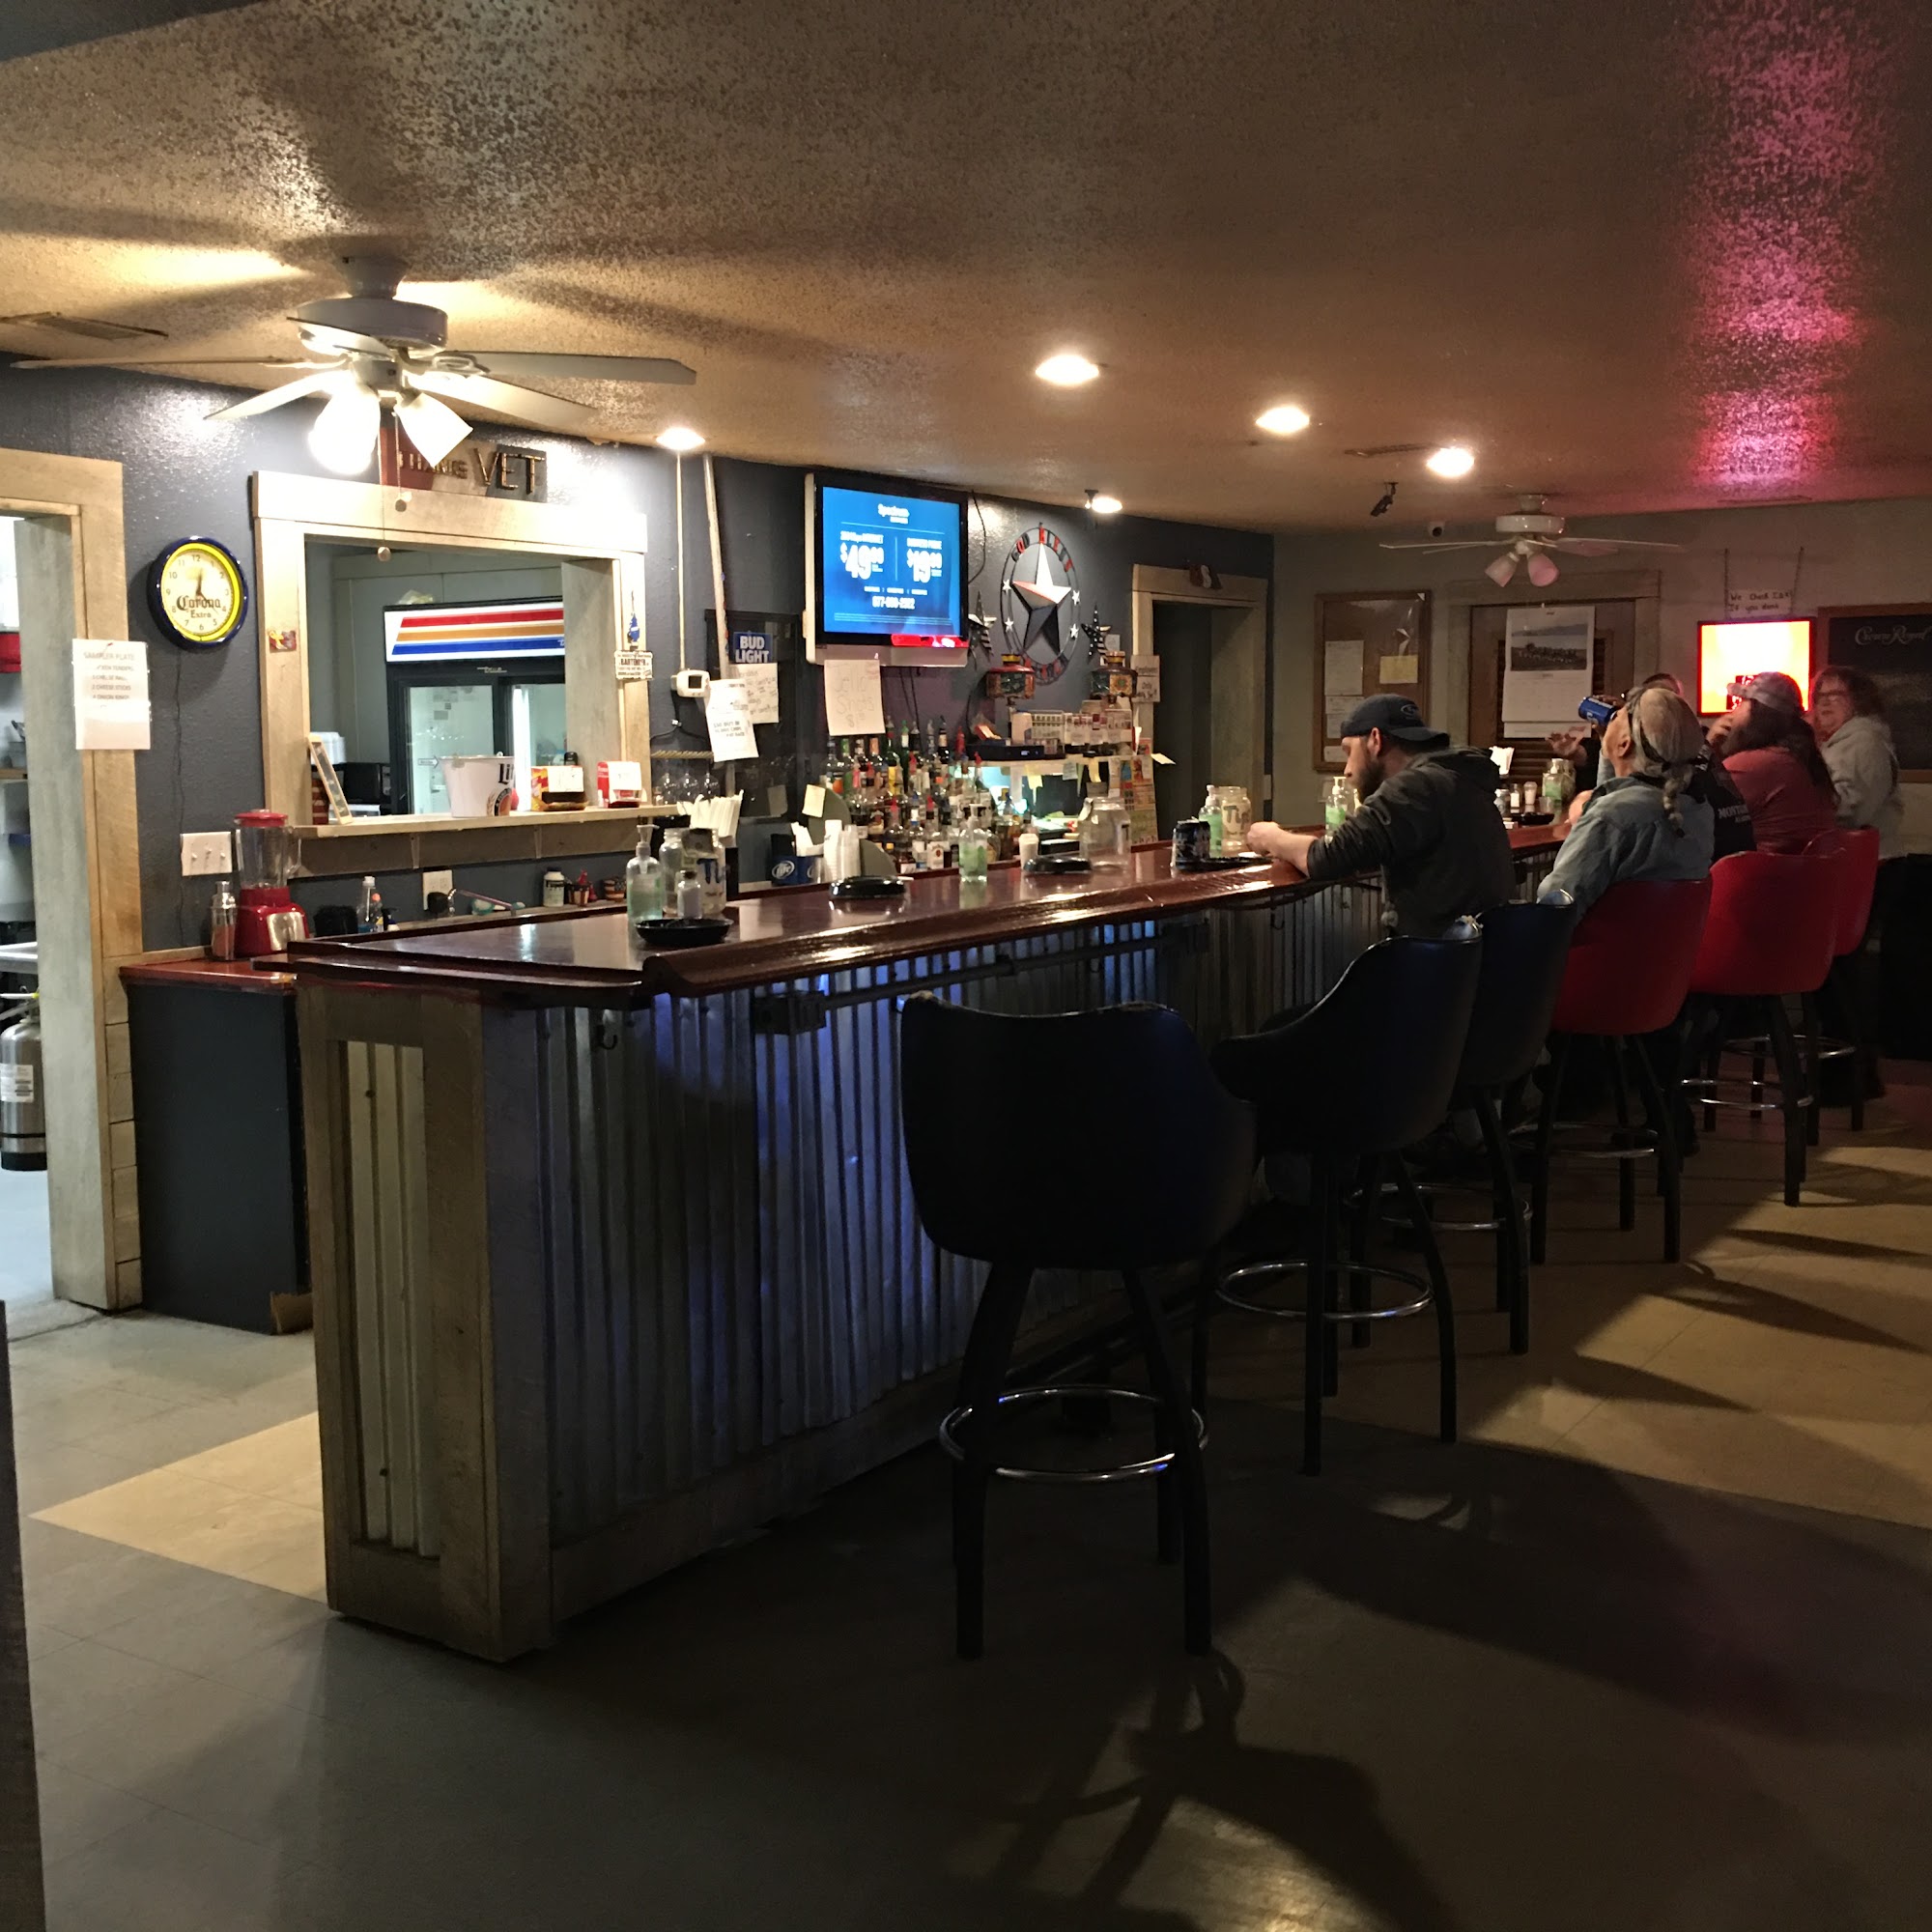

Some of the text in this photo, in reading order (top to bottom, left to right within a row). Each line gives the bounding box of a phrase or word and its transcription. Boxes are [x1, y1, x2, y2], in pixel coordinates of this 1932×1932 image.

[473, 447, 545, 493] VET
[176, 595, 221, 611] Corona
[190, 610, 212, 618] Extra
[740, 636, 765, 650] BUD
[736, 650, 770, 664] LIGHT
